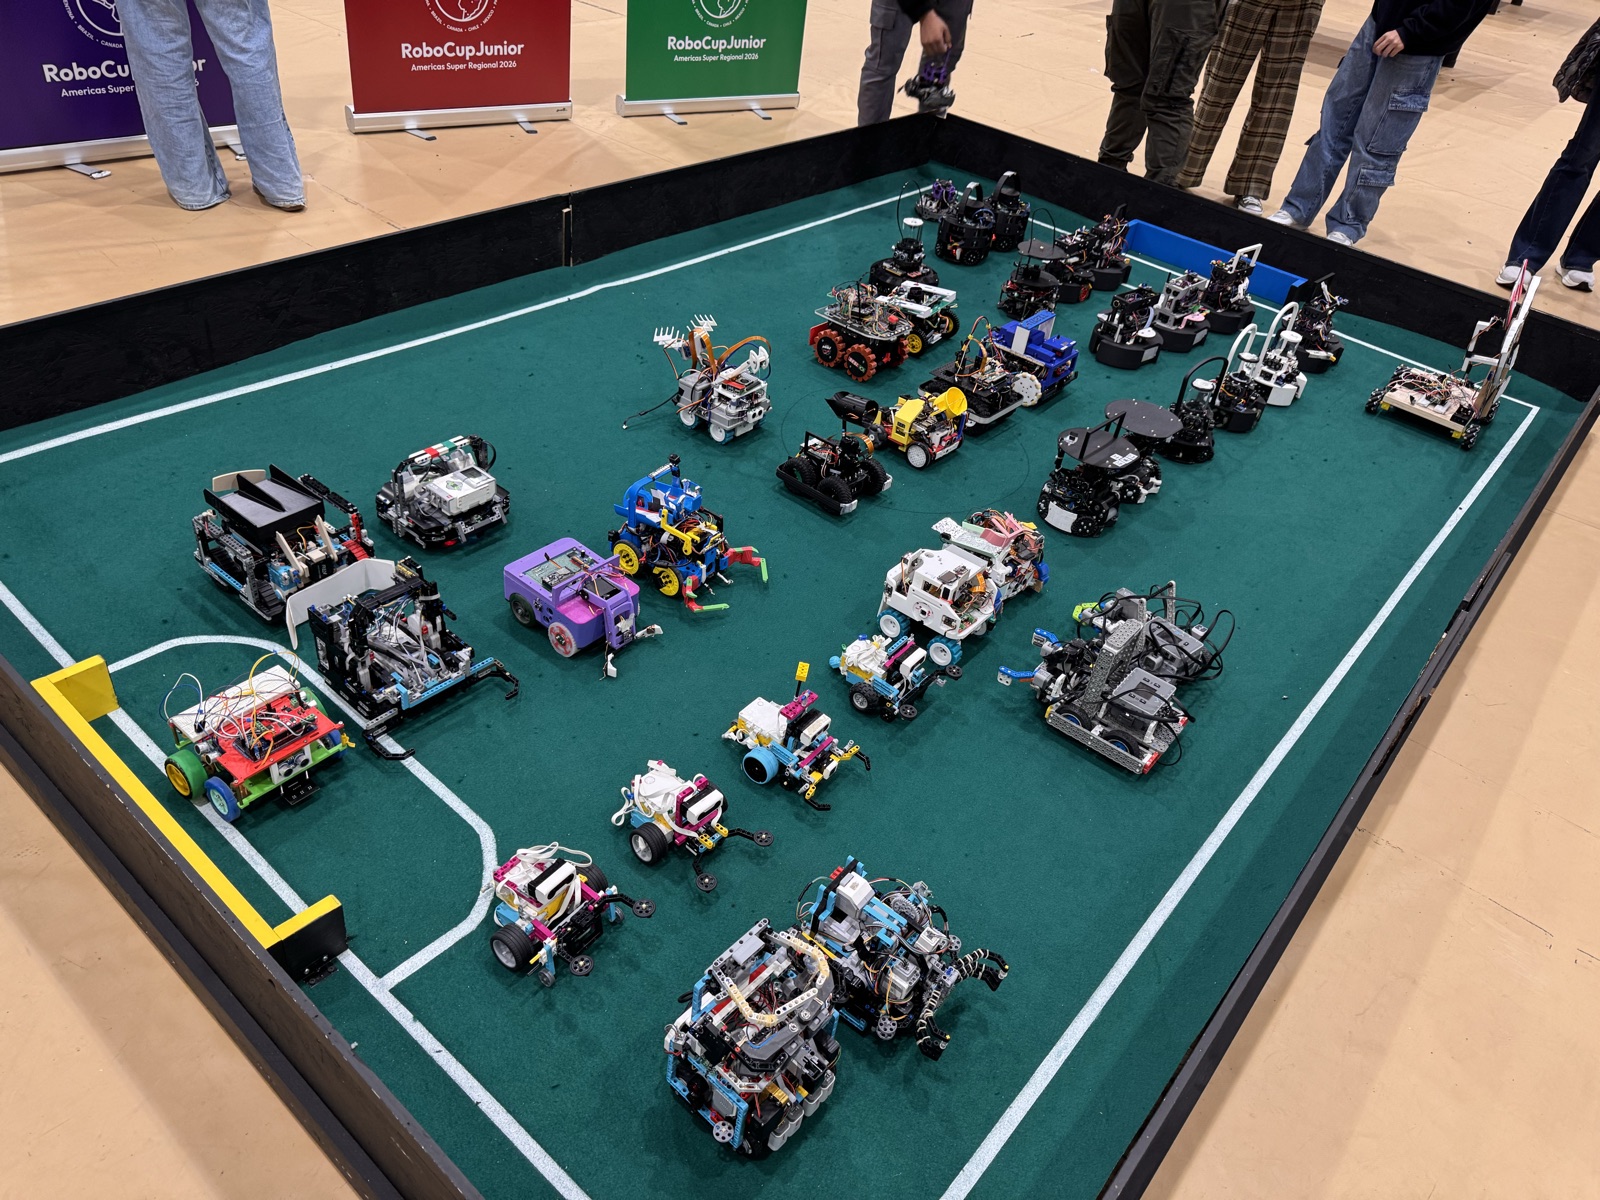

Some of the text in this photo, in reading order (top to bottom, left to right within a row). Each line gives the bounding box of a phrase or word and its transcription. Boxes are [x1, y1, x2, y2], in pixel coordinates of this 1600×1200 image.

[77, 24, 94, 40] BRAZIL
[100, 40, 124, 49] CANADA
[401, 40, 524, 60] RoboCupJunior
[668, 36, 766, 52] RoboCupJunior
[702, 54, 719, 62] Super
[720, 53, 744, 62] Regional
[411, 60, 517, 72] Americas Super Regional 2026
[61, 84, 135, 97] Americas Super
